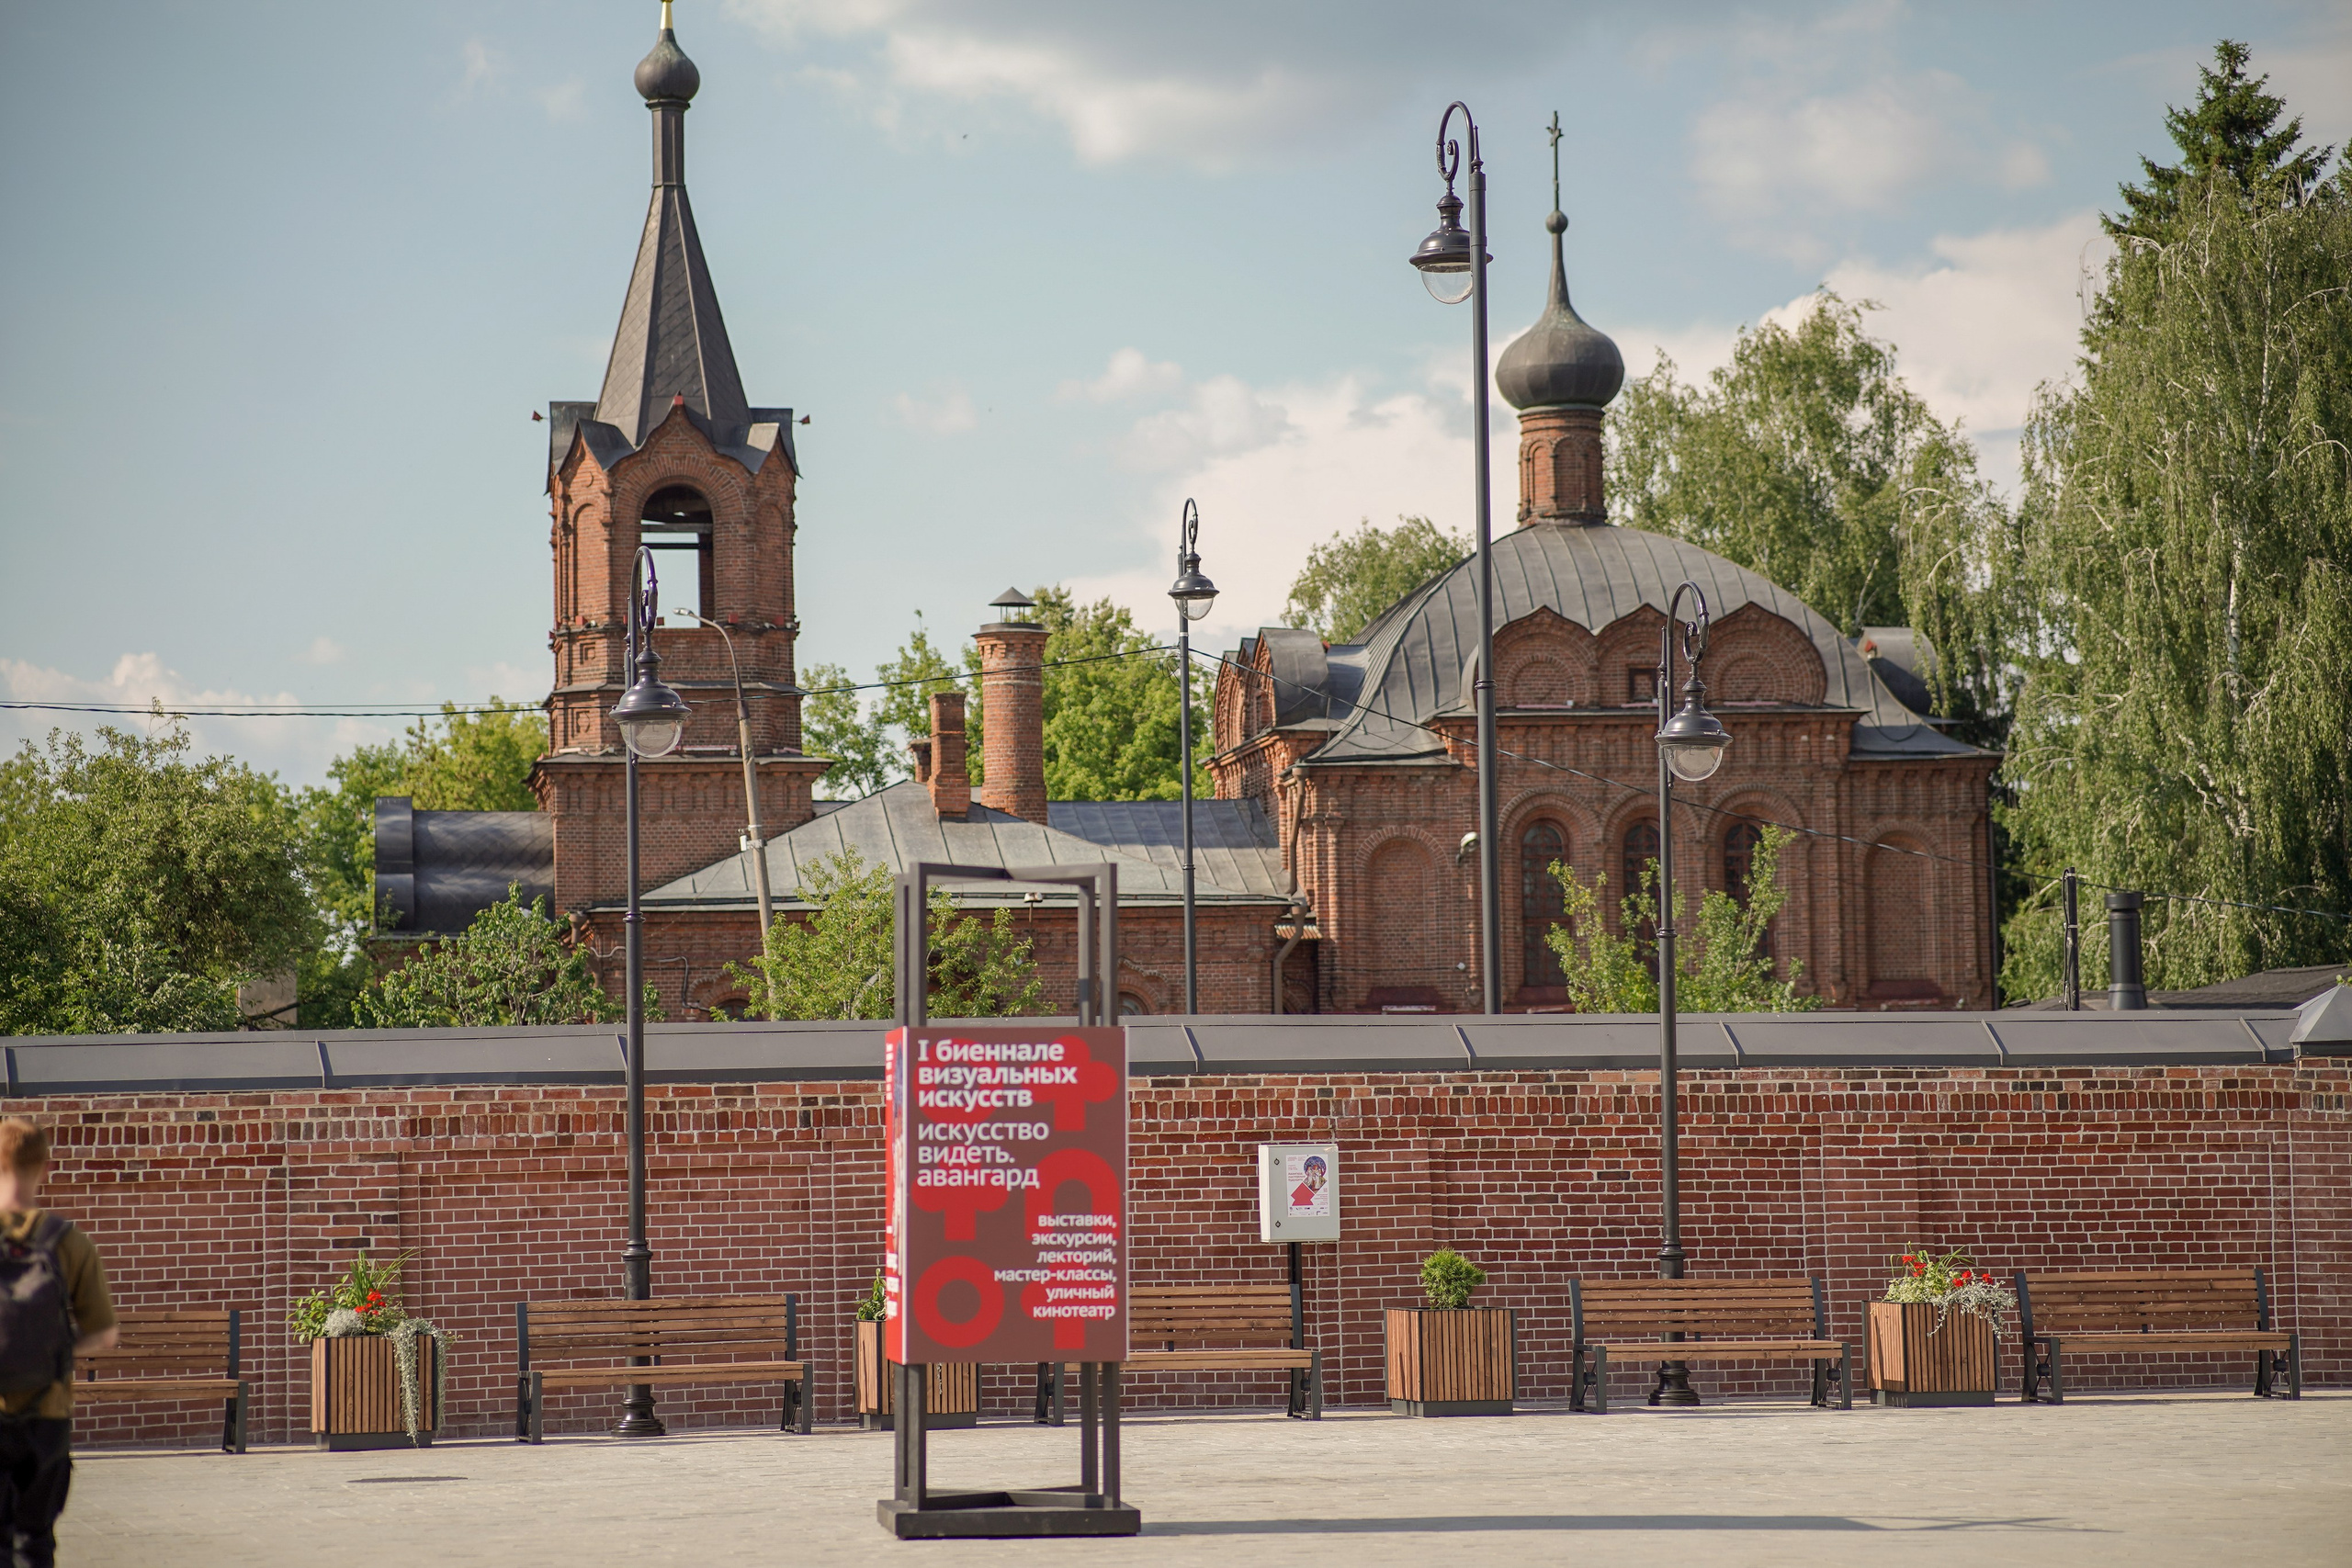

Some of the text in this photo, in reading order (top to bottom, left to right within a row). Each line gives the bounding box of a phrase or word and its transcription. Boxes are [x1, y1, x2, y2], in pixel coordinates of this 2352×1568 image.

[918, 1039, 928, 1061] I
[935, 1039, 1065, 1062] биеннале
[918, 1066, 1078, 1089] визуальных
[918, 1089, 1033, 1112] искусств
[918, 1122, 1049, 1145] искусство
[918, 1145, 1015, 1167] видеть.
[917, 1168, 1040, 1190] авангард
[1038, 1214, 1117, 1228] выставки,
[1031, 1232, 1117, 1247] экскурсии,
[1036, 1248, 1117, 1265] лекторий,
[994, 1269, 1117, 1283] мастер-классы,
[1046, 1285, 1114, 1303] уличный
[1033, 1306, 1115, 1320] кинотеатр
